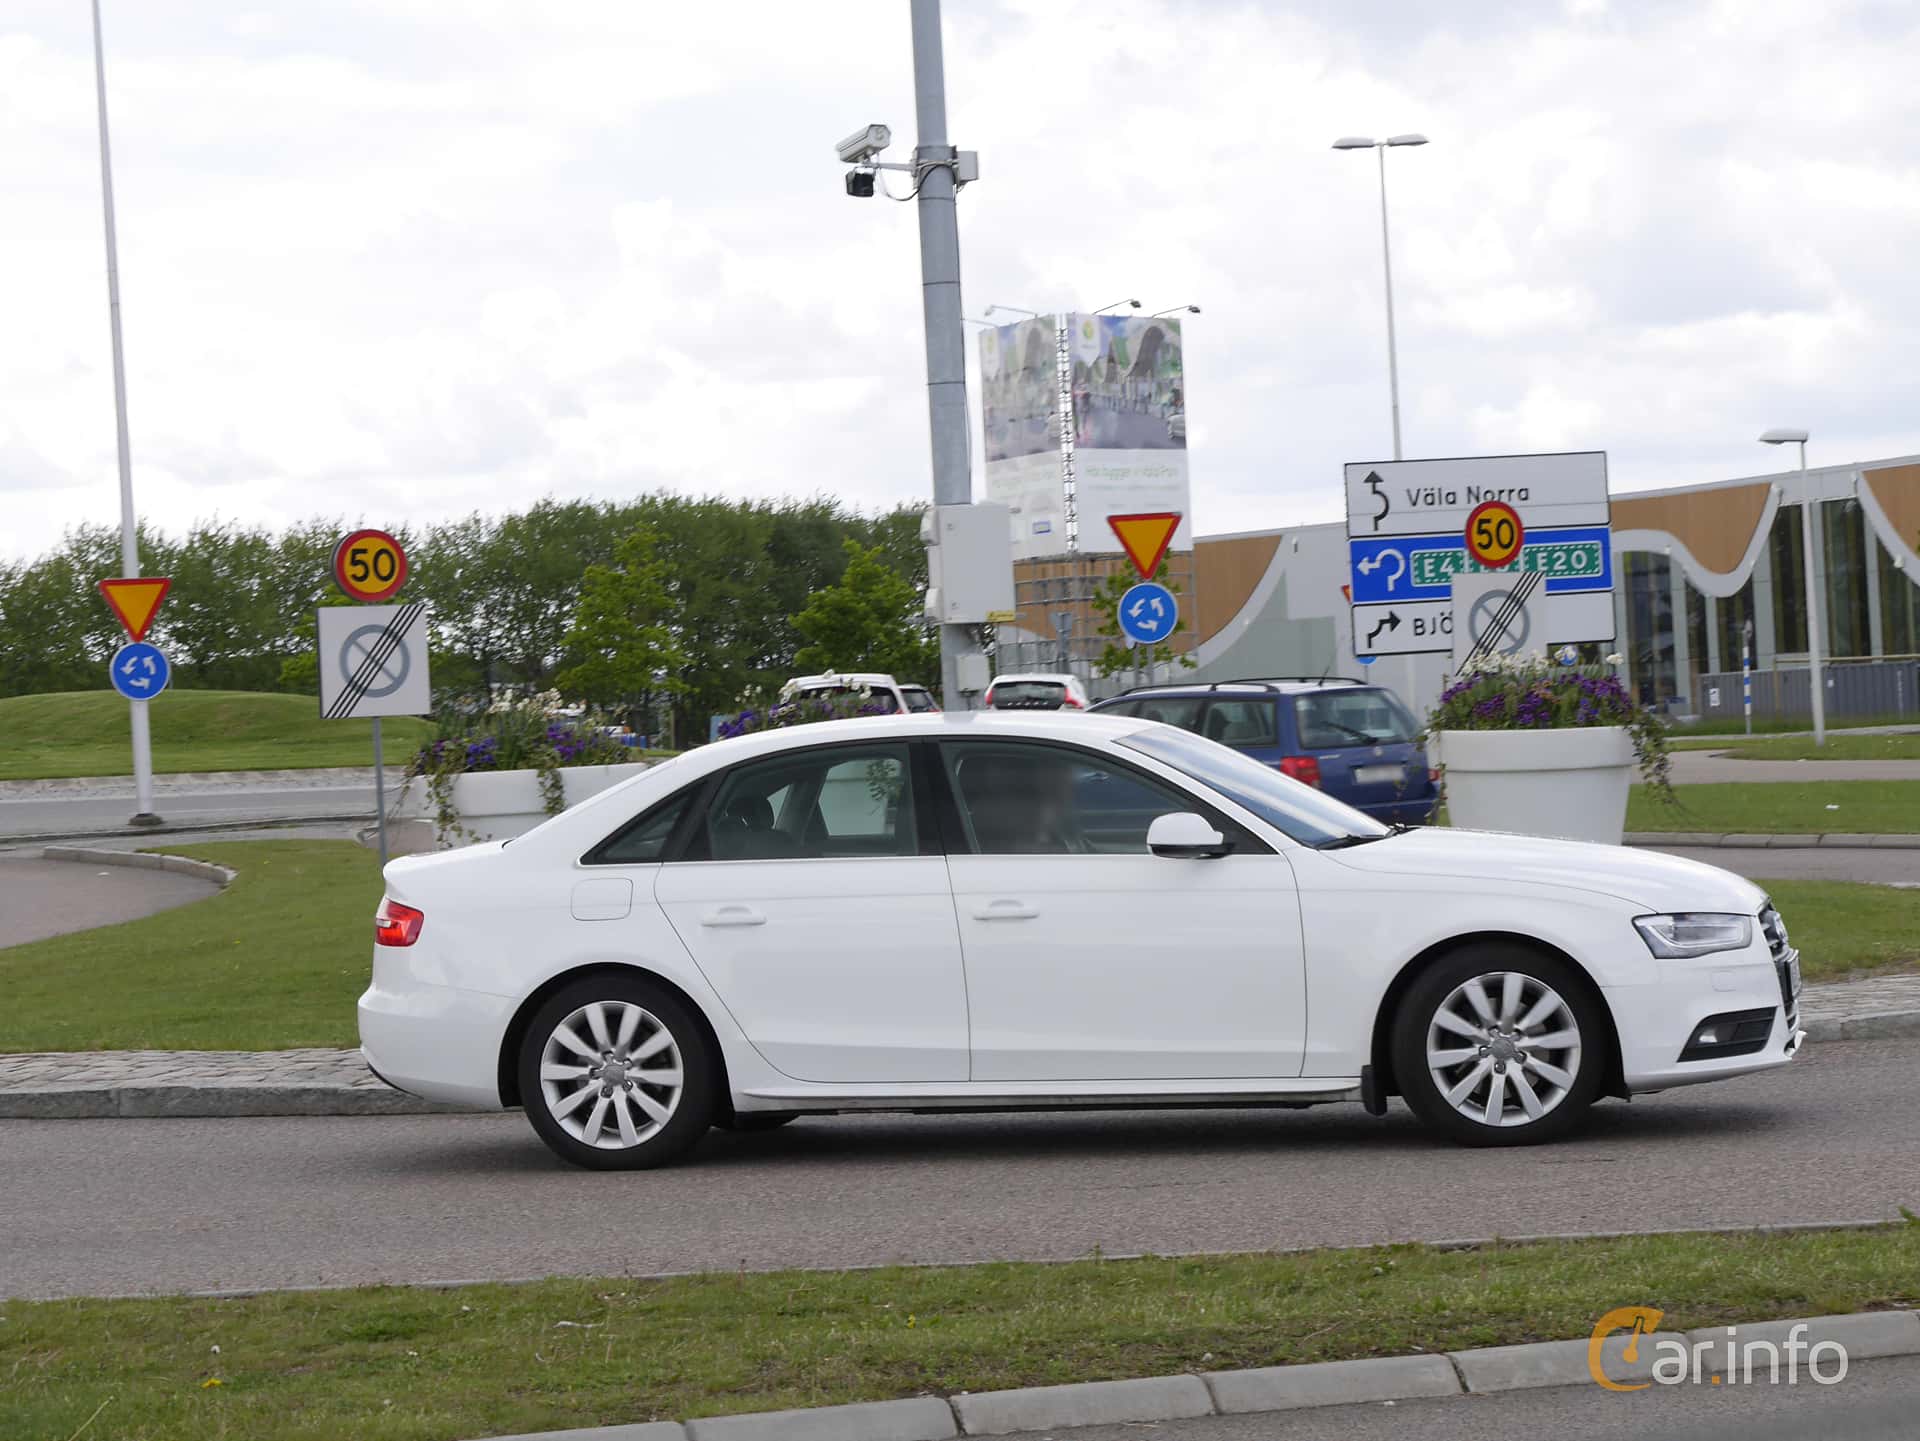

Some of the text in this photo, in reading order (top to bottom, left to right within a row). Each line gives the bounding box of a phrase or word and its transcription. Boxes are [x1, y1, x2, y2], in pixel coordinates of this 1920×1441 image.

[1406, 485, 1529, 507] Väla Norra
[1476, 518, 1514, 550] 50
[351, 548, 396, 582] 50
[1423, 557, 1454, 578] E4
[1536, 549, 1588, 571] E20
